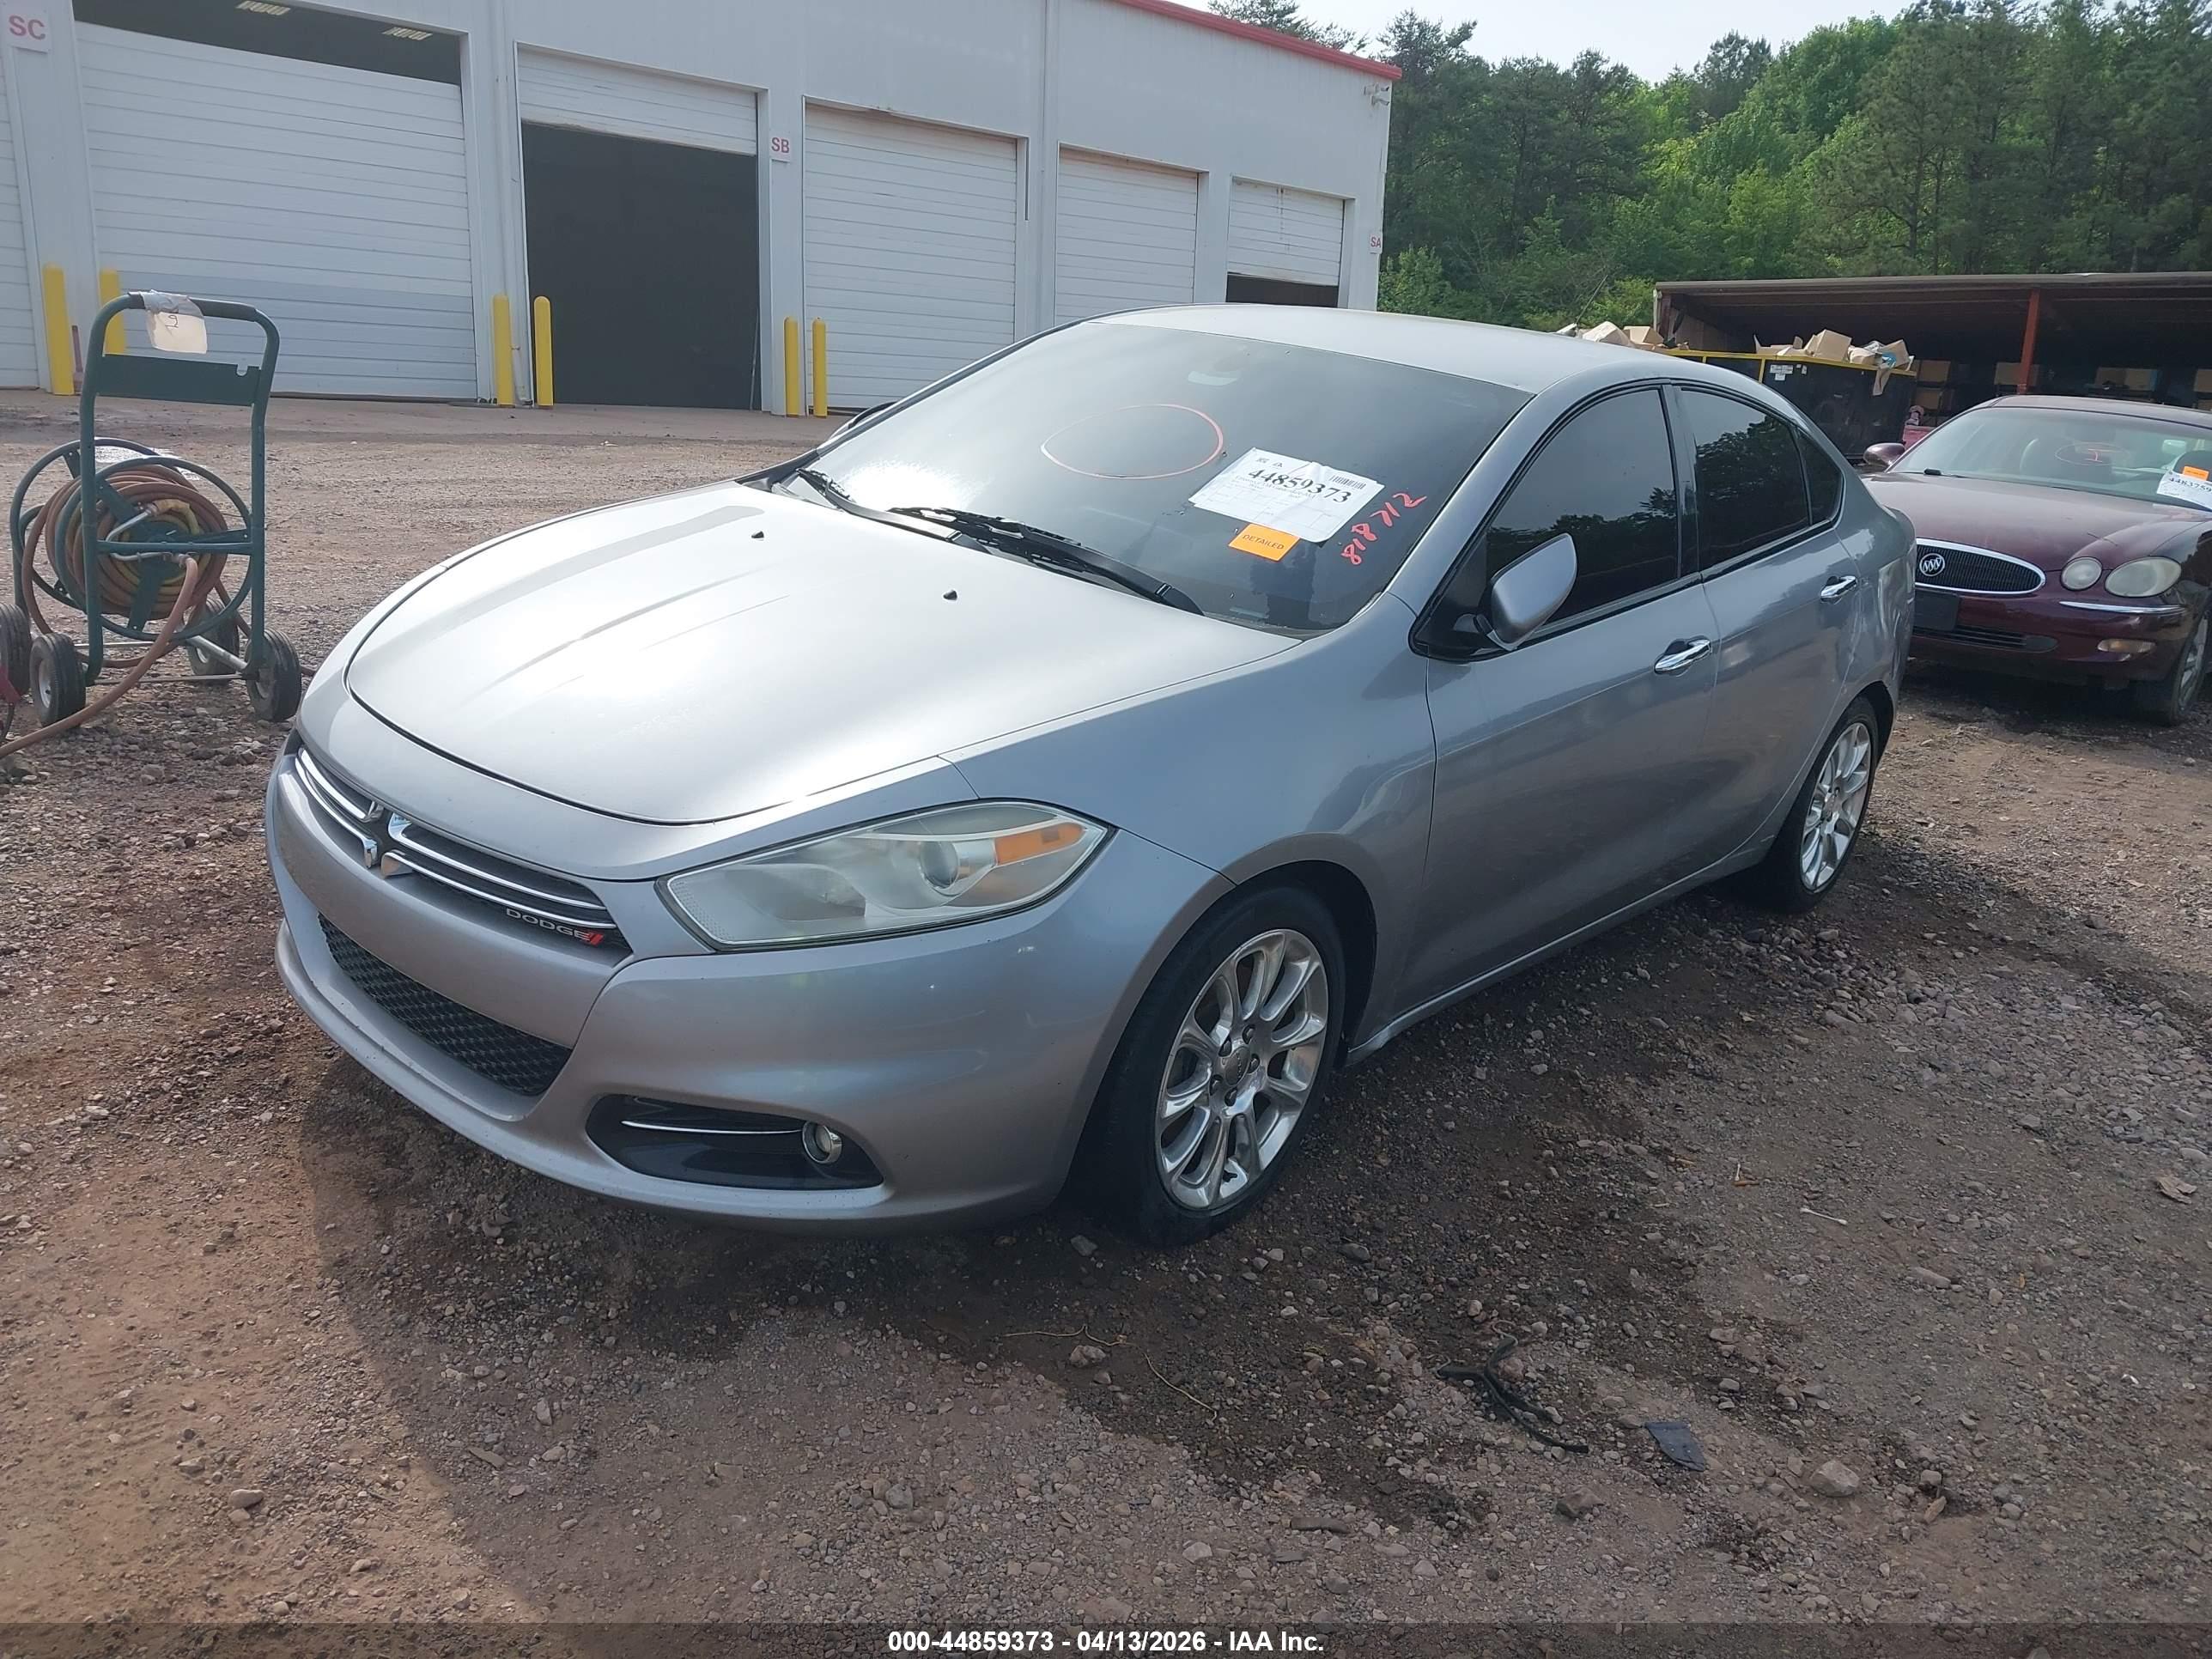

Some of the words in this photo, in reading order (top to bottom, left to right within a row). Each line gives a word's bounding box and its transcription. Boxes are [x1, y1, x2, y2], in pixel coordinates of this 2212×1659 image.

[9, 15, 46, 40] SC
[771, 137, 790, 154] SB
[1370, 236, 1382, 248] SA
[1248, 468, 1352, 503] 44859373
[1242, 533, 1285, 550] DETAILED
[505, 907, 592, 942] DODGE
